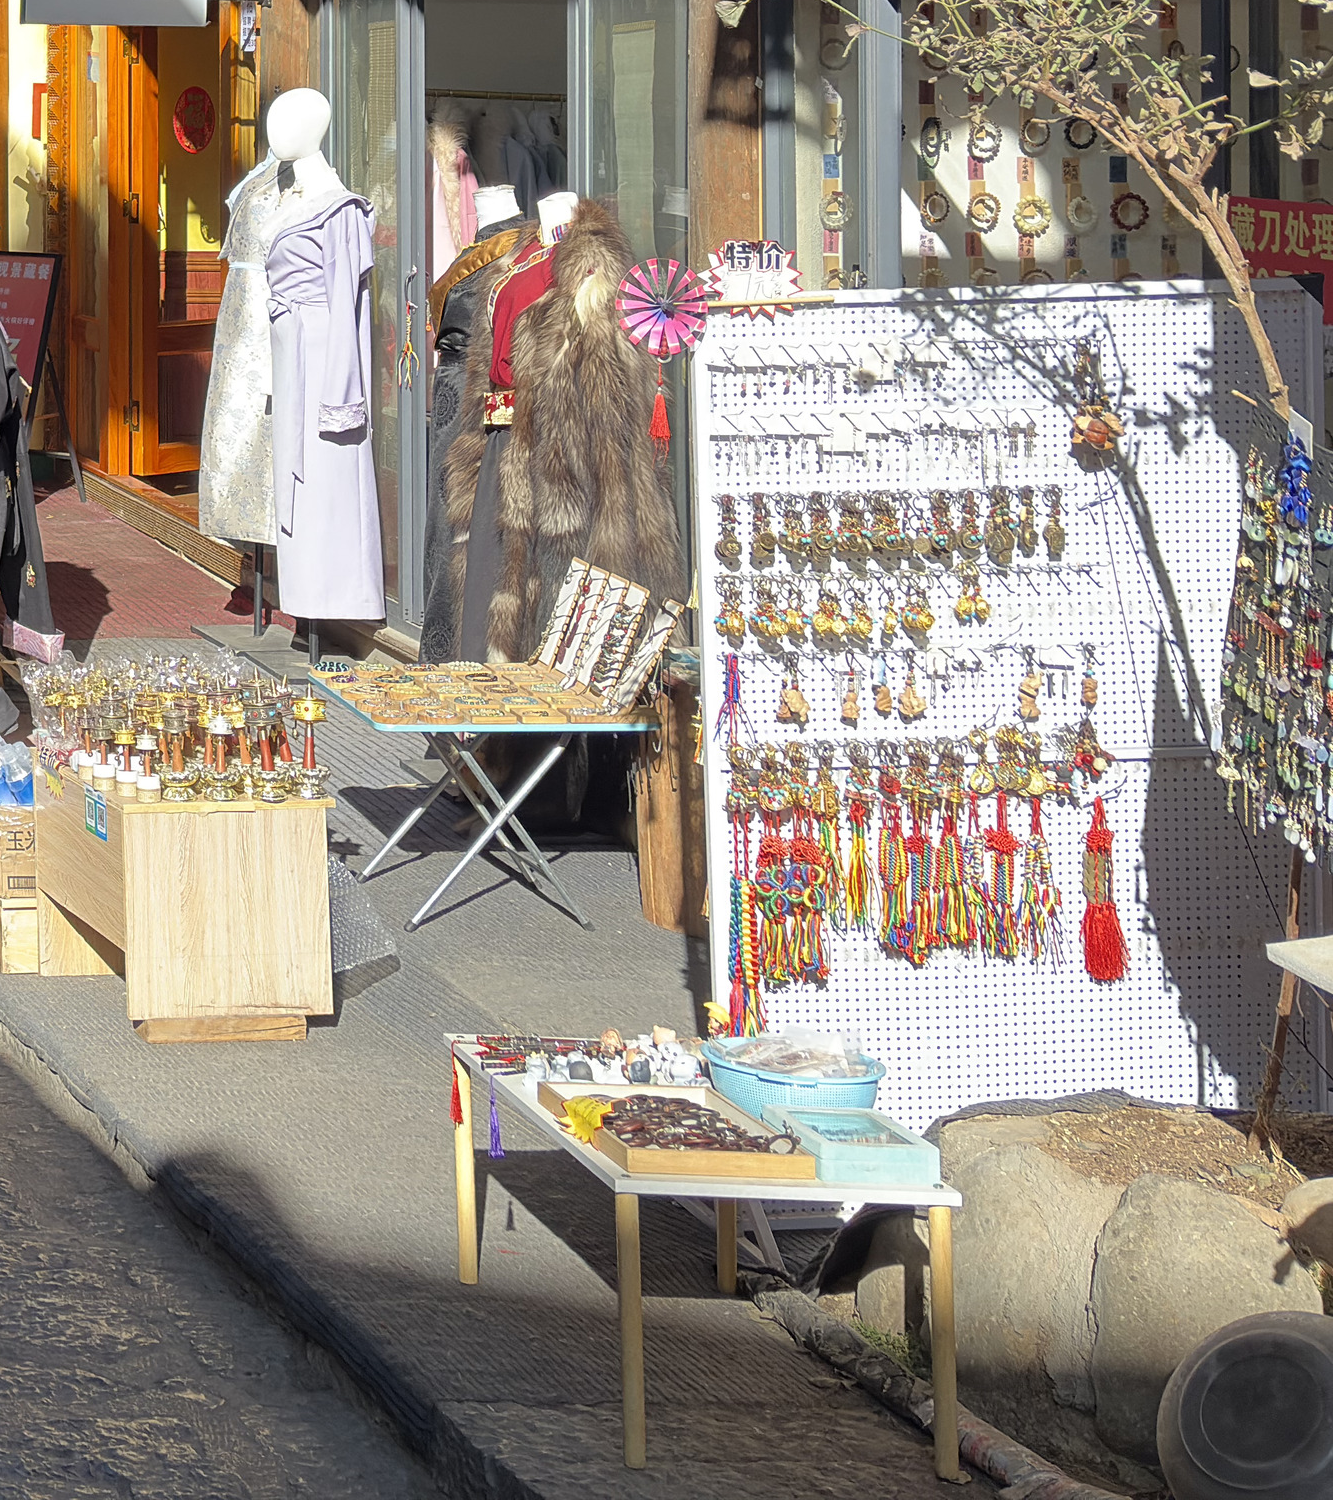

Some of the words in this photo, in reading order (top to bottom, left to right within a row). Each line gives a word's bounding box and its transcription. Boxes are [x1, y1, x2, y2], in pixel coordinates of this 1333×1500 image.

[1231, 203, 1333, 261] 藏刀处理
[725, 241, 785, 271] 特价
